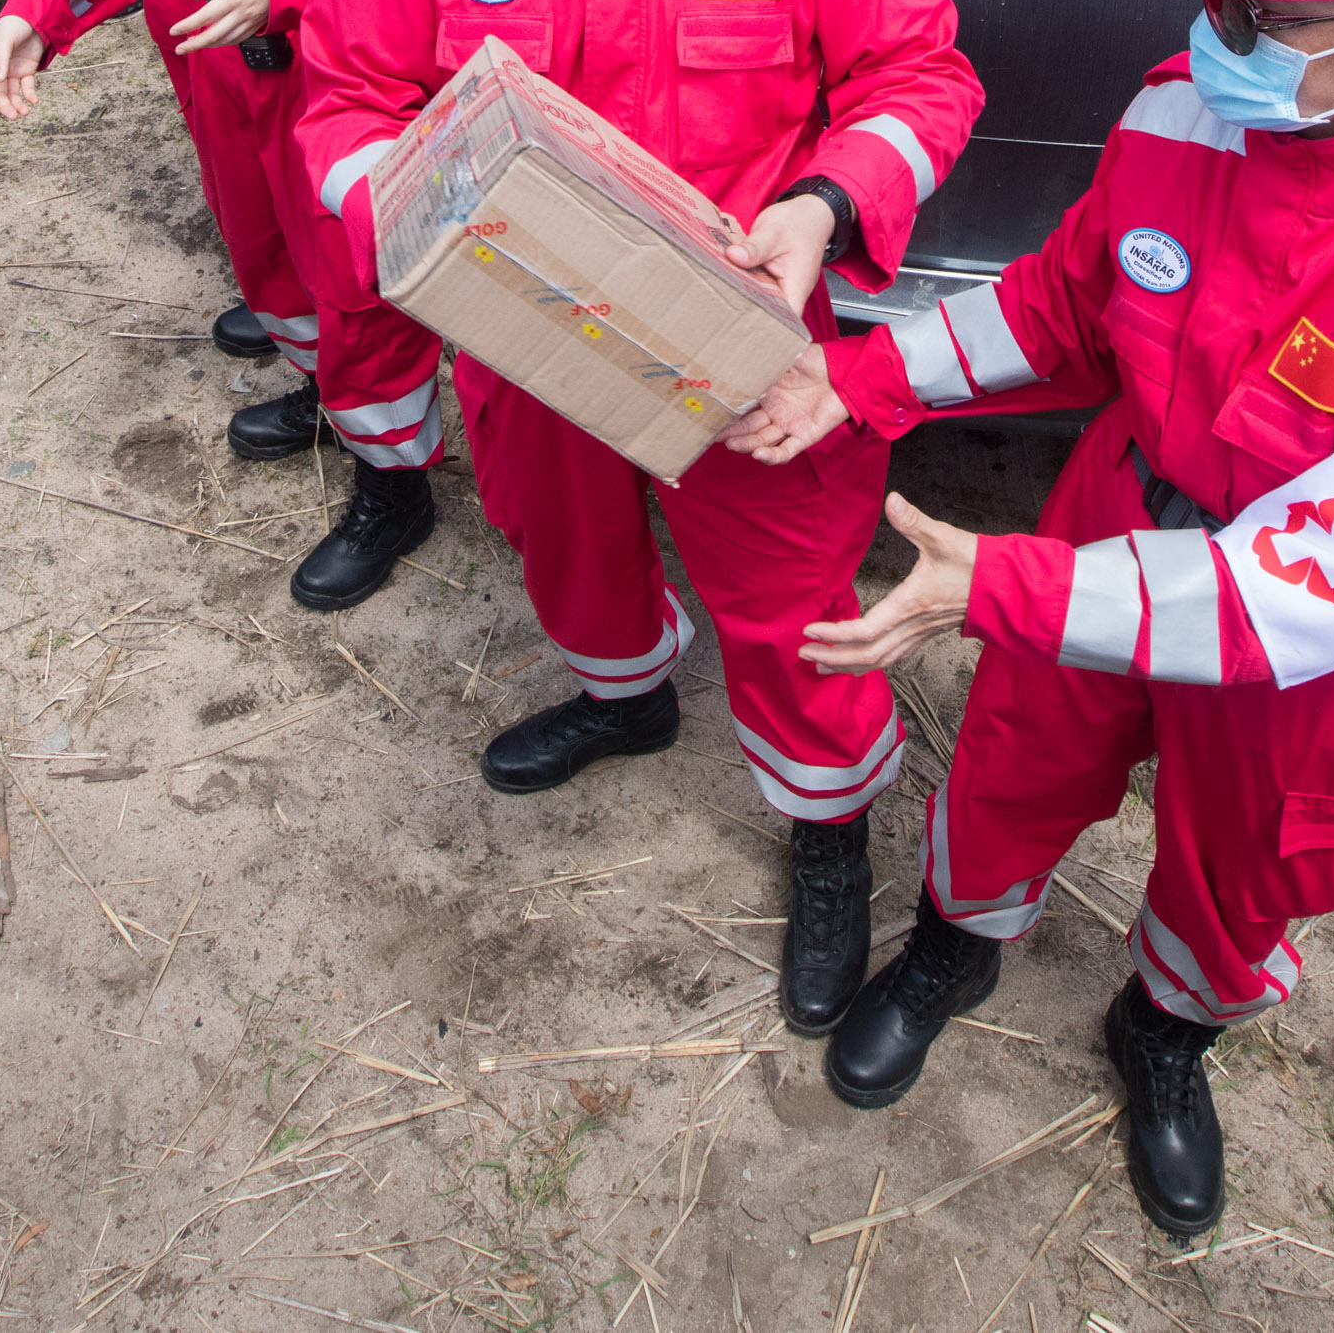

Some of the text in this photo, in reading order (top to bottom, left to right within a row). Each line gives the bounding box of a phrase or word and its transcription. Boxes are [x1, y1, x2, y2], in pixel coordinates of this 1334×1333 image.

[464, 221, 508, 237] GOLF
[1129, 245, 1176, 279] INSARAG
[1132, 233, 1186, 270] UNITED NATIONS
[1133, 260, 1162, 281] Classified
[1133, 270, 1145, 283] USAR
